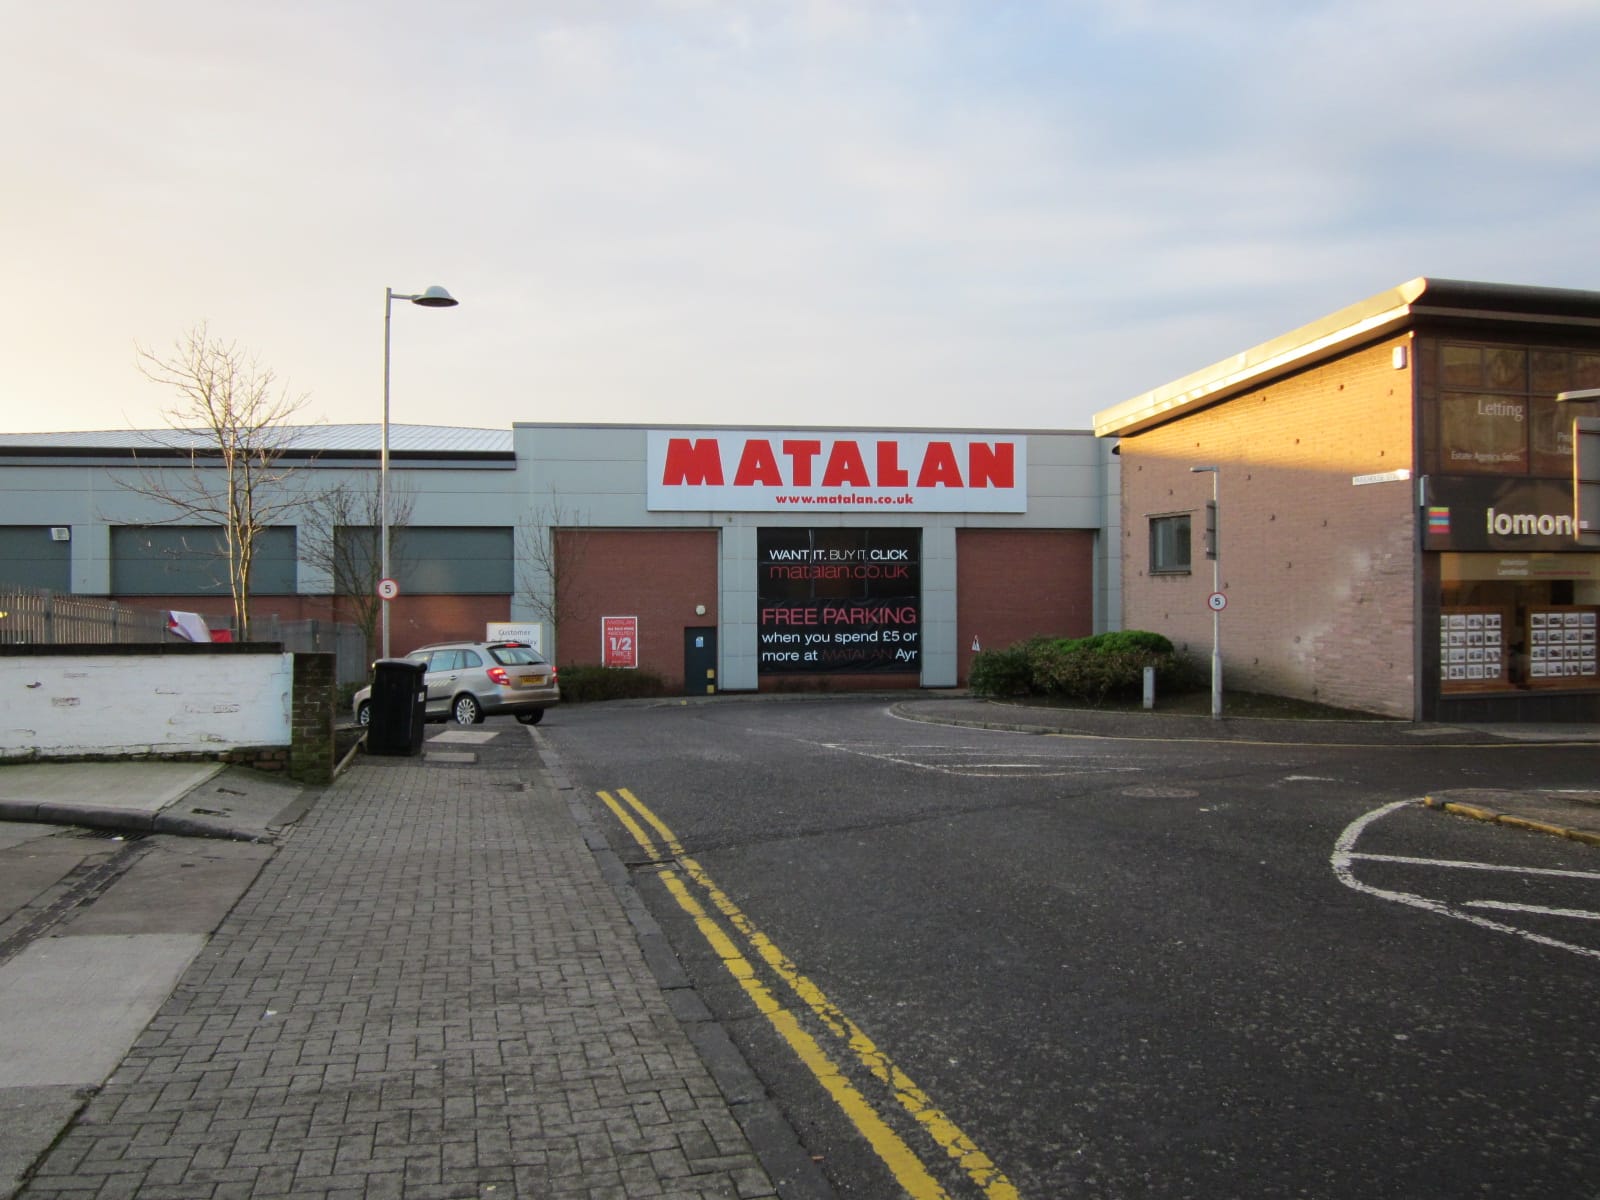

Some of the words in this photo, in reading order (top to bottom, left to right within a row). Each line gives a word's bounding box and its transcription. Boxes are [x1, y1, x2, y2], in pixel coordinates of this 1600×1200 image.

[1477, 400, 1524, 422] Letting
[662, 438, 1014, 488] MATALAN
[776, 493, 913, 505] www.matalan.co.uk
[1487, 507, 1573, 535] lomon
[769, 549, 809, 560] WANT
[829, 549, 857, 560] BUY
[870, 549, 908, 560] CLICK
[769, 564, 909, 580] matalan.co.uk
[384, 584, 392, 594] 5
[1214, 597, 1221, 606] 5
[762, 608, 818, 625] FREE
[823, 607, 917, 625] PARKING
[610, 637, 632, 650] 1/2
[762, 632, 800, 643] when
[804, 633, 830, 645] you
[834, 631, 878, 645] spend
[883, 630, 900, 642] £5
[903, 632, 917, 641] or
[762, 651, 799, 661] more
[804, 650, 818, 661] at
[895, 648, 917, 662] Ayr
